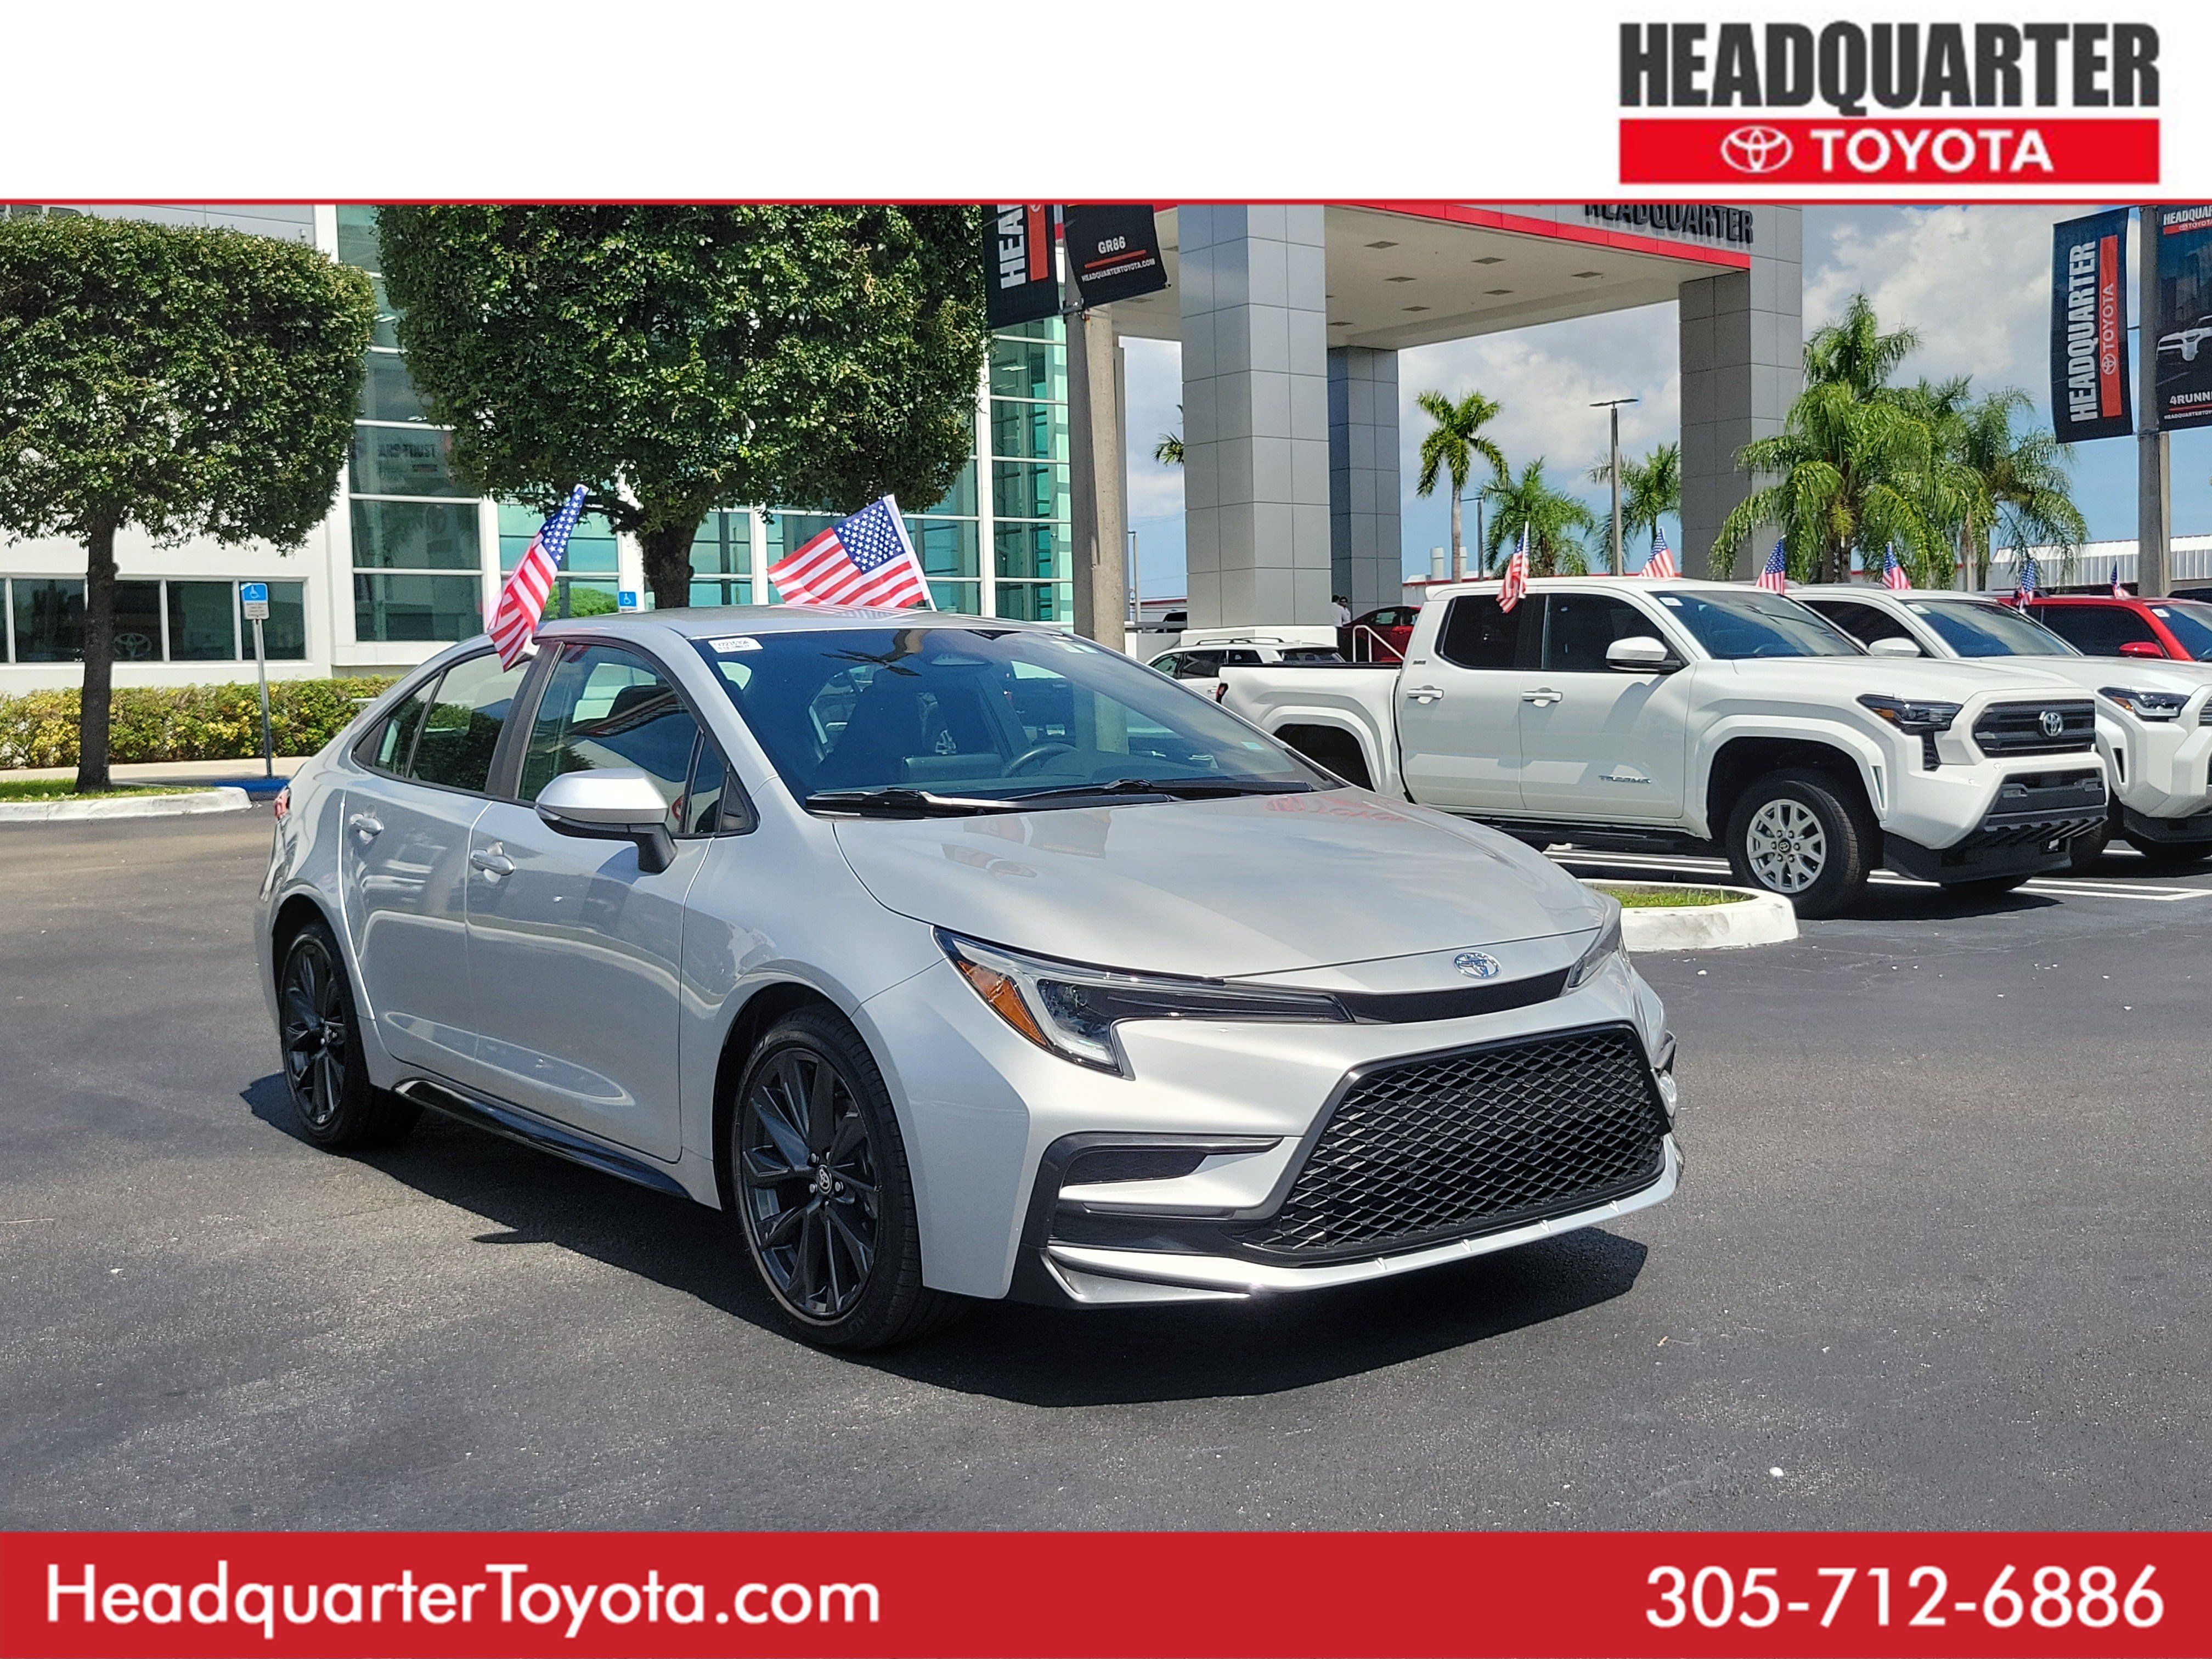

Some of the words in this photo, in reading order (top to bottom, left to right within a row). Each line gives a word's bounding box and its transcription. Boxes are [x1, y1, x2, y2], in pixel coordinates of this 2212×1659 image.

[1098, 236, 1126, 254] GR86
[2067, 240, 2099, 422] HEADQUARTER
[2102, 283, 2115, 353] TOYOTA
[2169, 391, 2212, 405] 4RUNN
